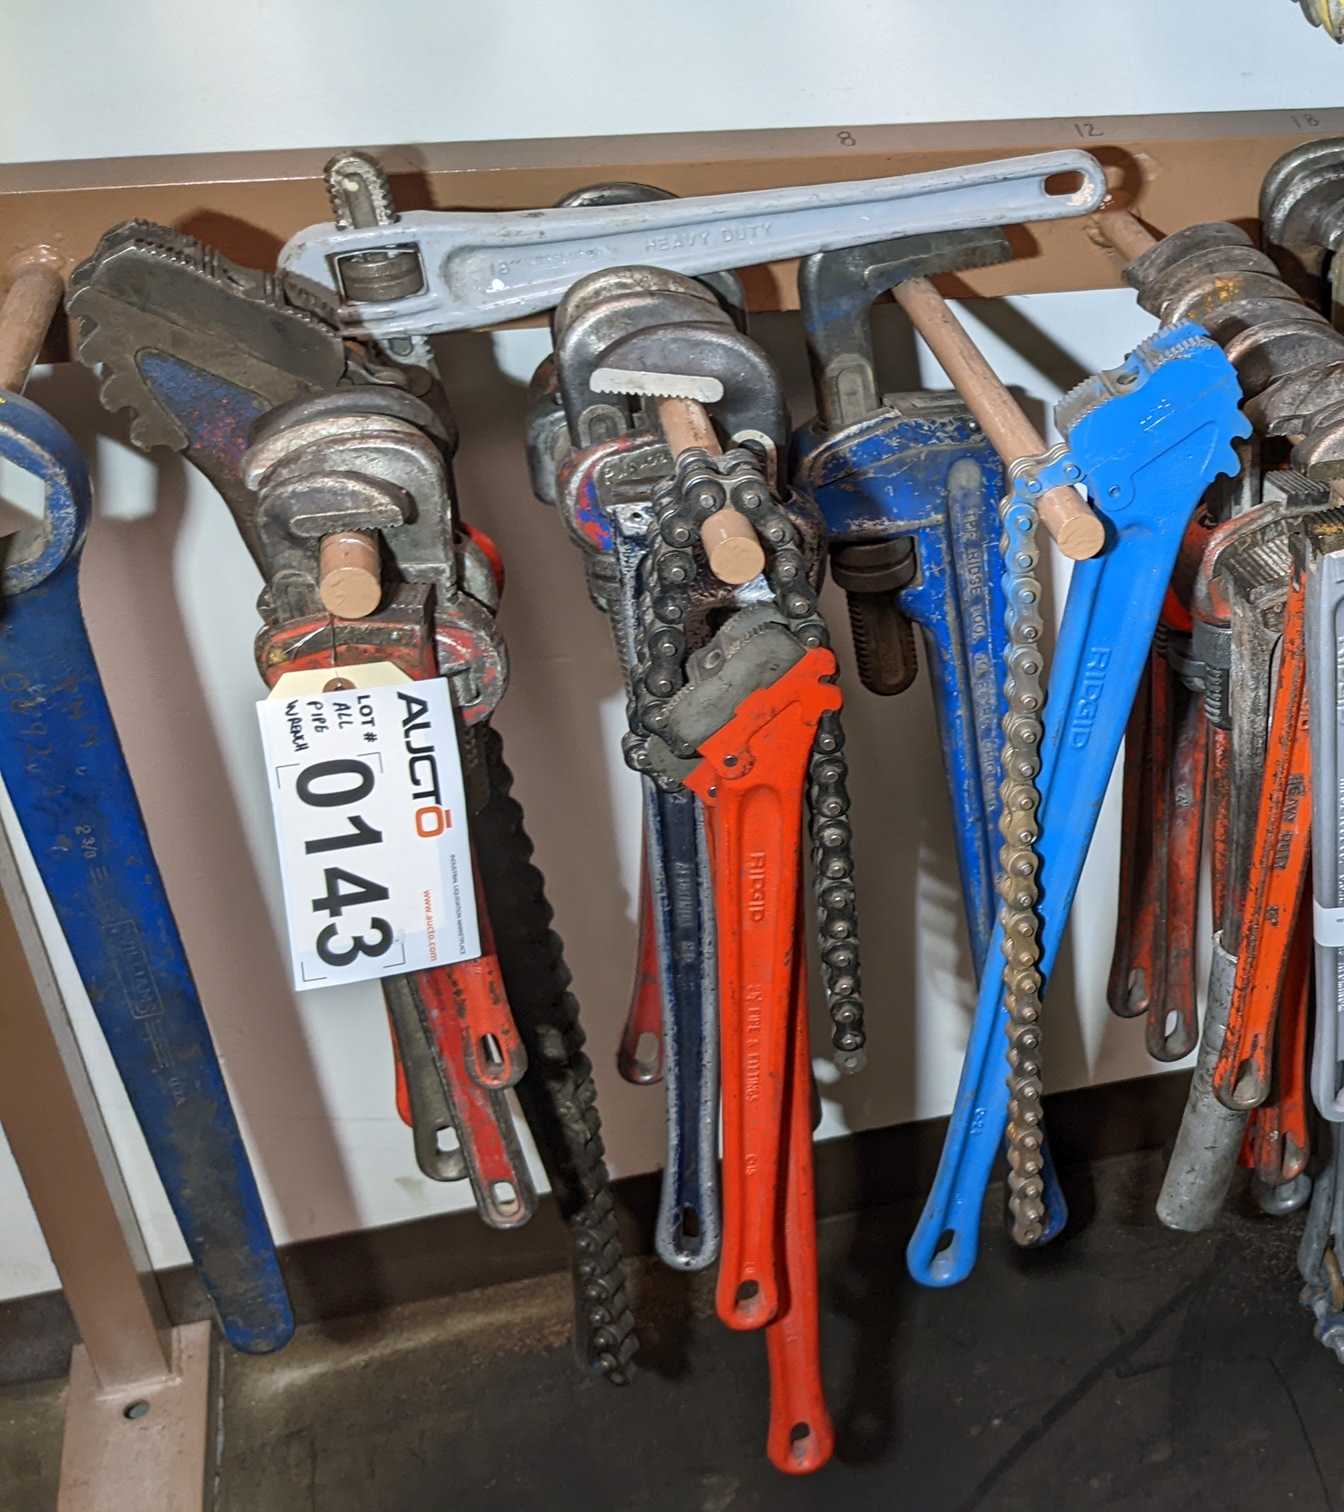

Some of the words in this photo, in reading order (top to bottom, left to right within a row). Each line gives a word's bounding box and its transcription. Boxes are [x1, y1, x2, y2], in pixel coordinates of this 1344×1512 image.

[1073, 123, 1104, 138] 12
[1290, 113, 1320, 128] 18
[836, 131, 856, 147] 8
[646, 231, 710, 252] HEAVY
[721, 221, 773, 243] DUTY
[357, 695, 375, 727] LOT
[1071, 647, 1112, 750] RIDGID
[285, 699, 308, 752] WRENCH
[307, 701, 326, 733] PIPE
[333, 702, 354, 729] ALL
[364, 732, 378, 743] #
[75, 824, 93, 835] 2
[295, 759, 394, 967] 0143
[745, 851, 766, 922] RIDGID
[423, 889, 439, 961] www.aucto.com
